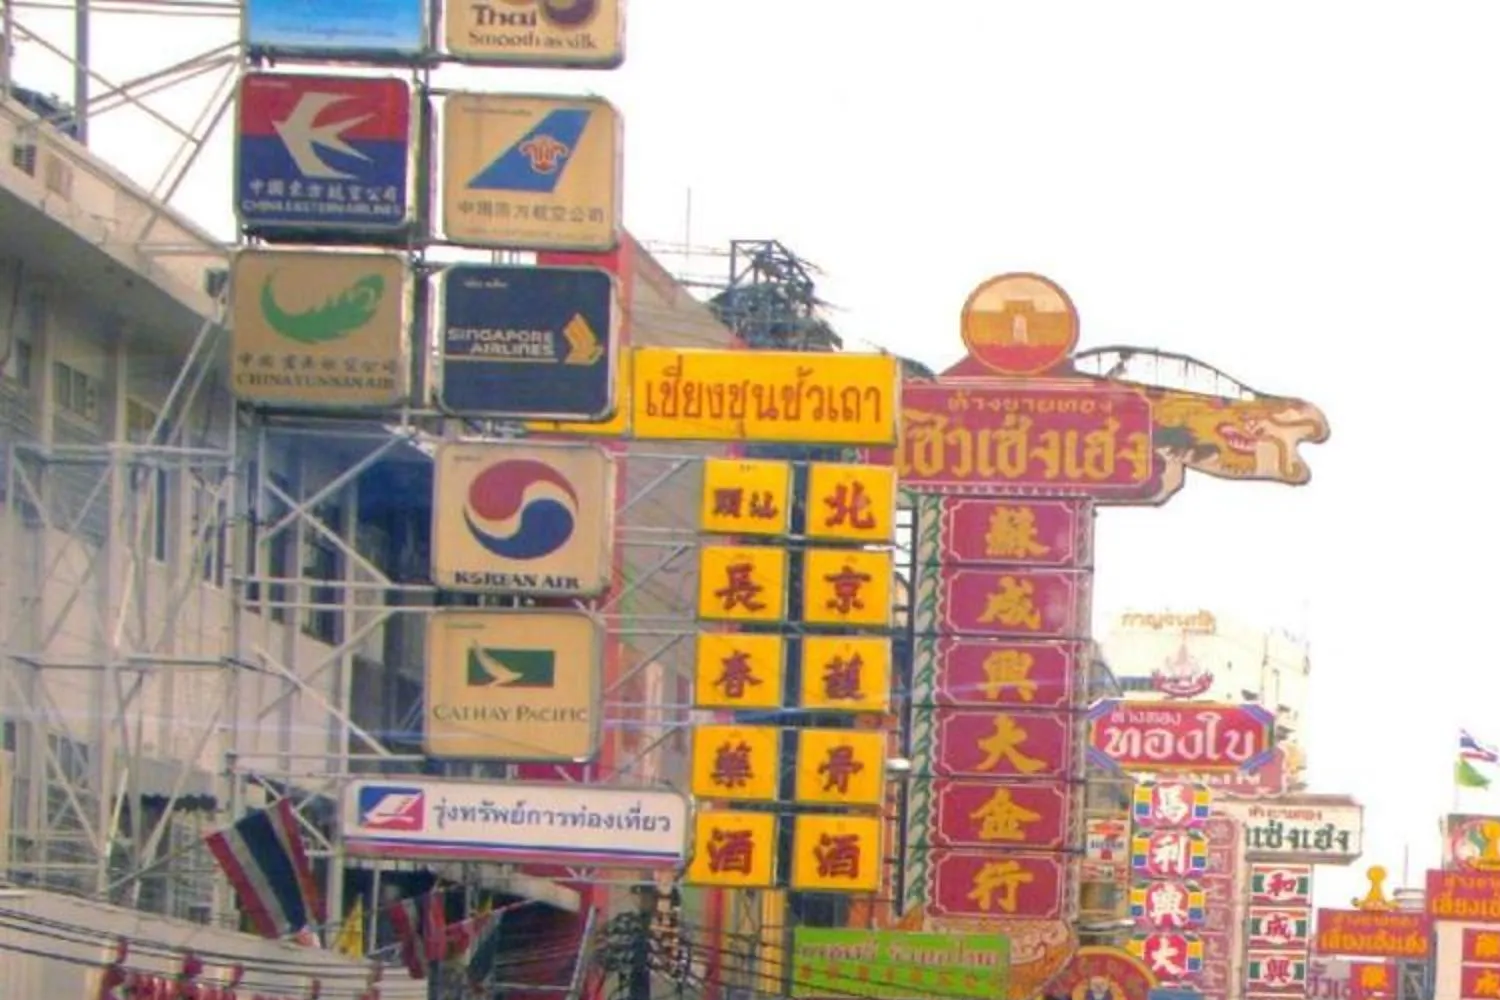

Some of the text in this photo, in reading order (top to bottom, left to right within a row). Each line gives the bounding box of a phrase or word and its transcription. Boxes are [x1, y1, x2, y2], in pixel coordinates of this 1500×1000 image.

[469, 32, 541, 47] Smooth
[447, 328, 555, 346] SINGAPORE
[470, 342, 556, 357] AIRLINES
[543, 574, 580, 590] AIR
[433, 704, 513, 722] CATHAY
